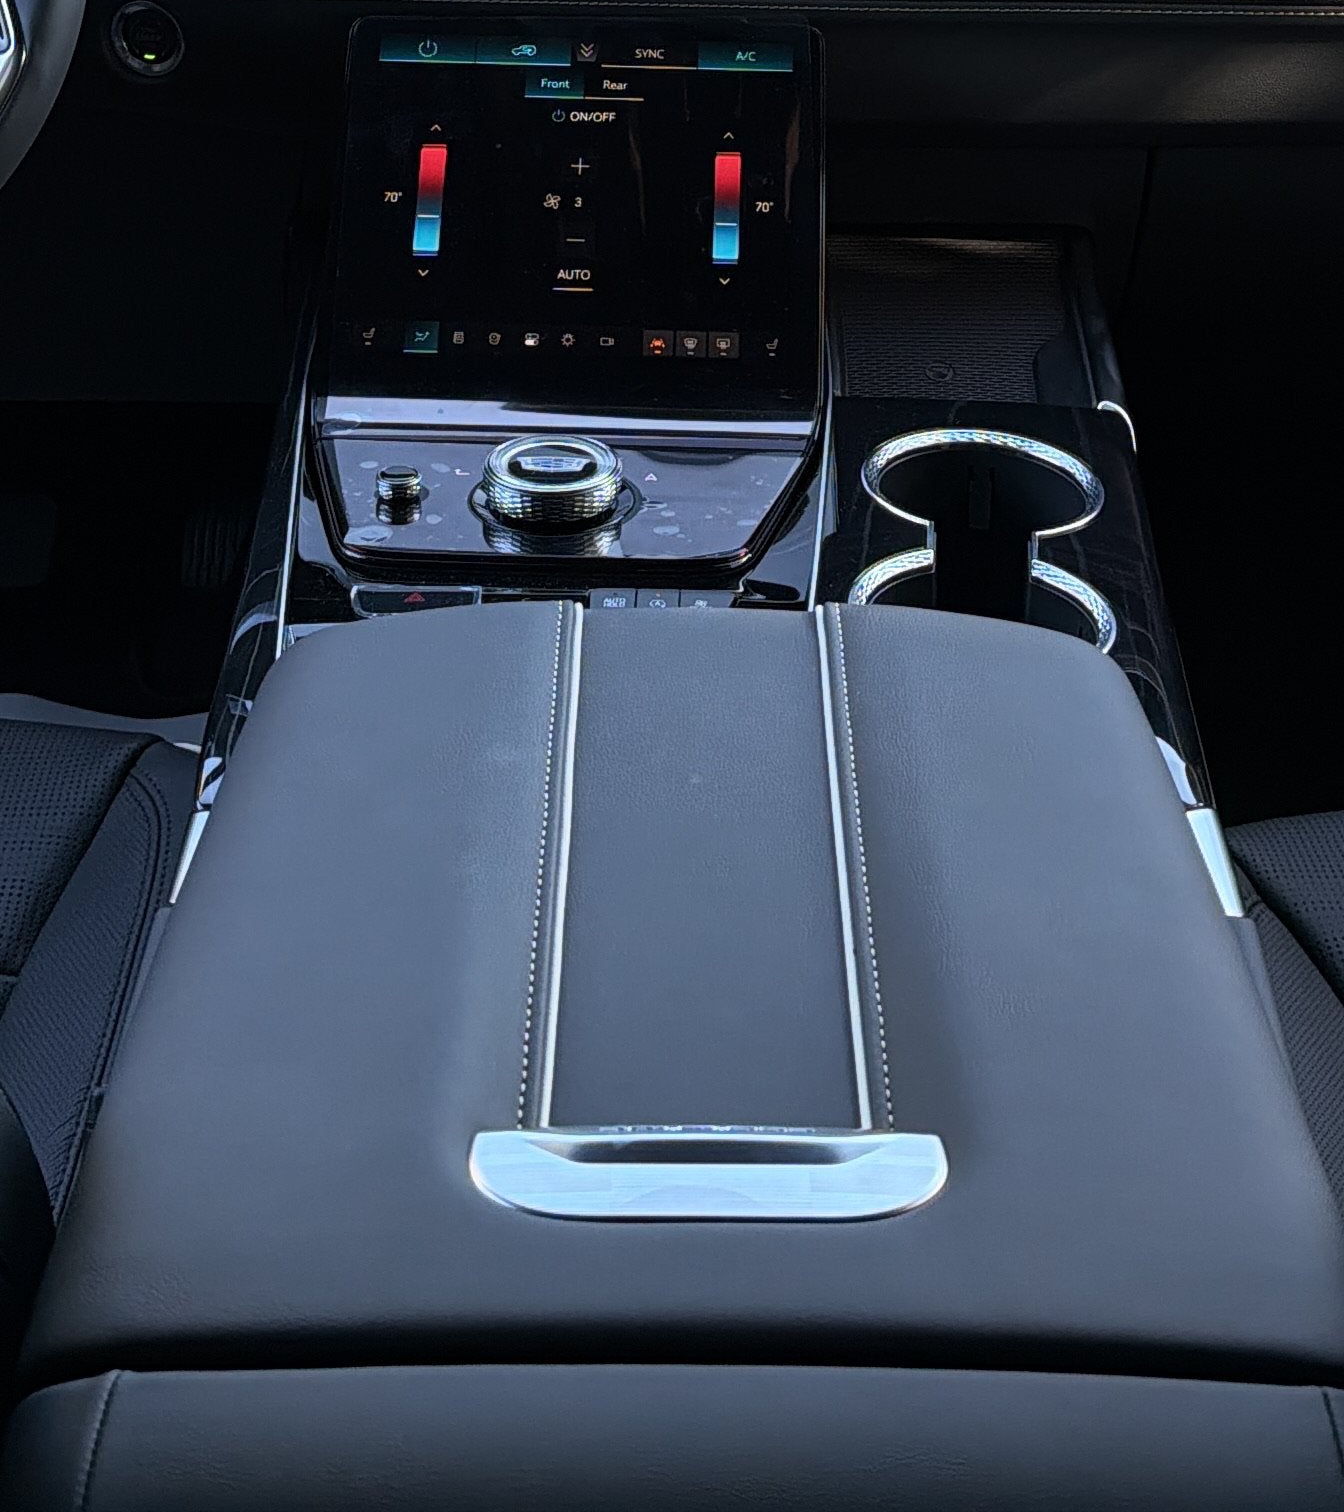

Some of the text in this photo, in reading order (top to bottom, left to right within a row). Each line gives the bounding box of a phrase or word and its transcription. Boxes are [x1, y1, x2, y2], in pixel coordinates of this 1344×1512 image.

[634, 48, 665, 59] SYNC
[735, 51, 756, 62] A/C
[540, 78, 570, 89] Front
[602, 79, 629, 90] Rear
[569, 111, 617, 123] ON/OFF
[383, 191, 403, 203] 70°
[574, 197, 582, 207] 3
[755, 201, 774, 213] 70°
[557, 269, 591, 281] AUTO
